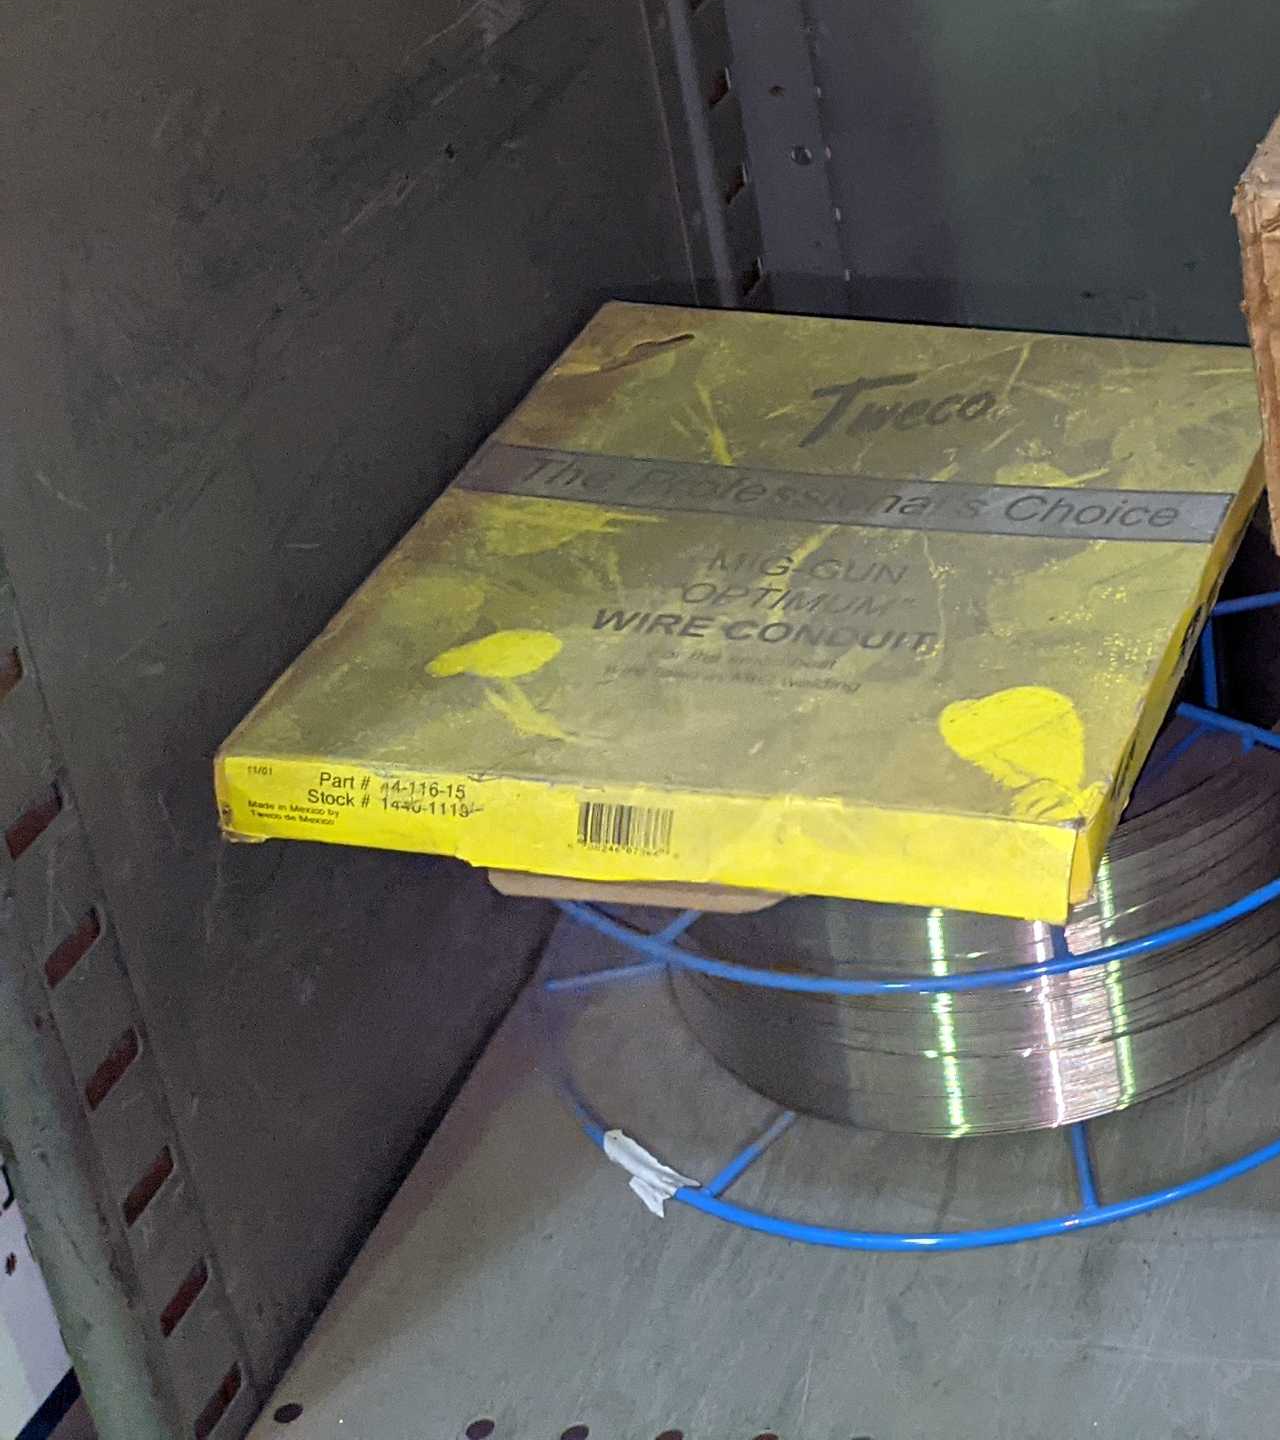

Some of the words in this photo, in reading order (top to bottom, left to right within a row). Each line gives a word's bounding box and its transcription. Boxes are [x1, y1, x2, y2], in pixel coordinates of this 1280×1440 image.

[798, 373, 997, 448] Tweco
[520, 457, 614, 491] The
[1003, 492, 1180, 528] Choice
[707, 550, 907, 586] MIG-GUN
[592, 607, 715, 639] WIRE
[724, 619, 940, 654] CONDUIT
[319, 772, 355, 790] Part
[360, 777, 371, 789] #
[247, 800, 275, 811] Made
[278, 803, 288, 811] in
[290, 804, 326, 816] Mexico
[327, 809, 340, 818] by
[307, 789, 355, 808] Stock
[360, 796, 371, 808] #
[250, 809, 282, 820] Tweco
[284, 813, 297, 822] de
[299, 814, 335, 825] Mexico
